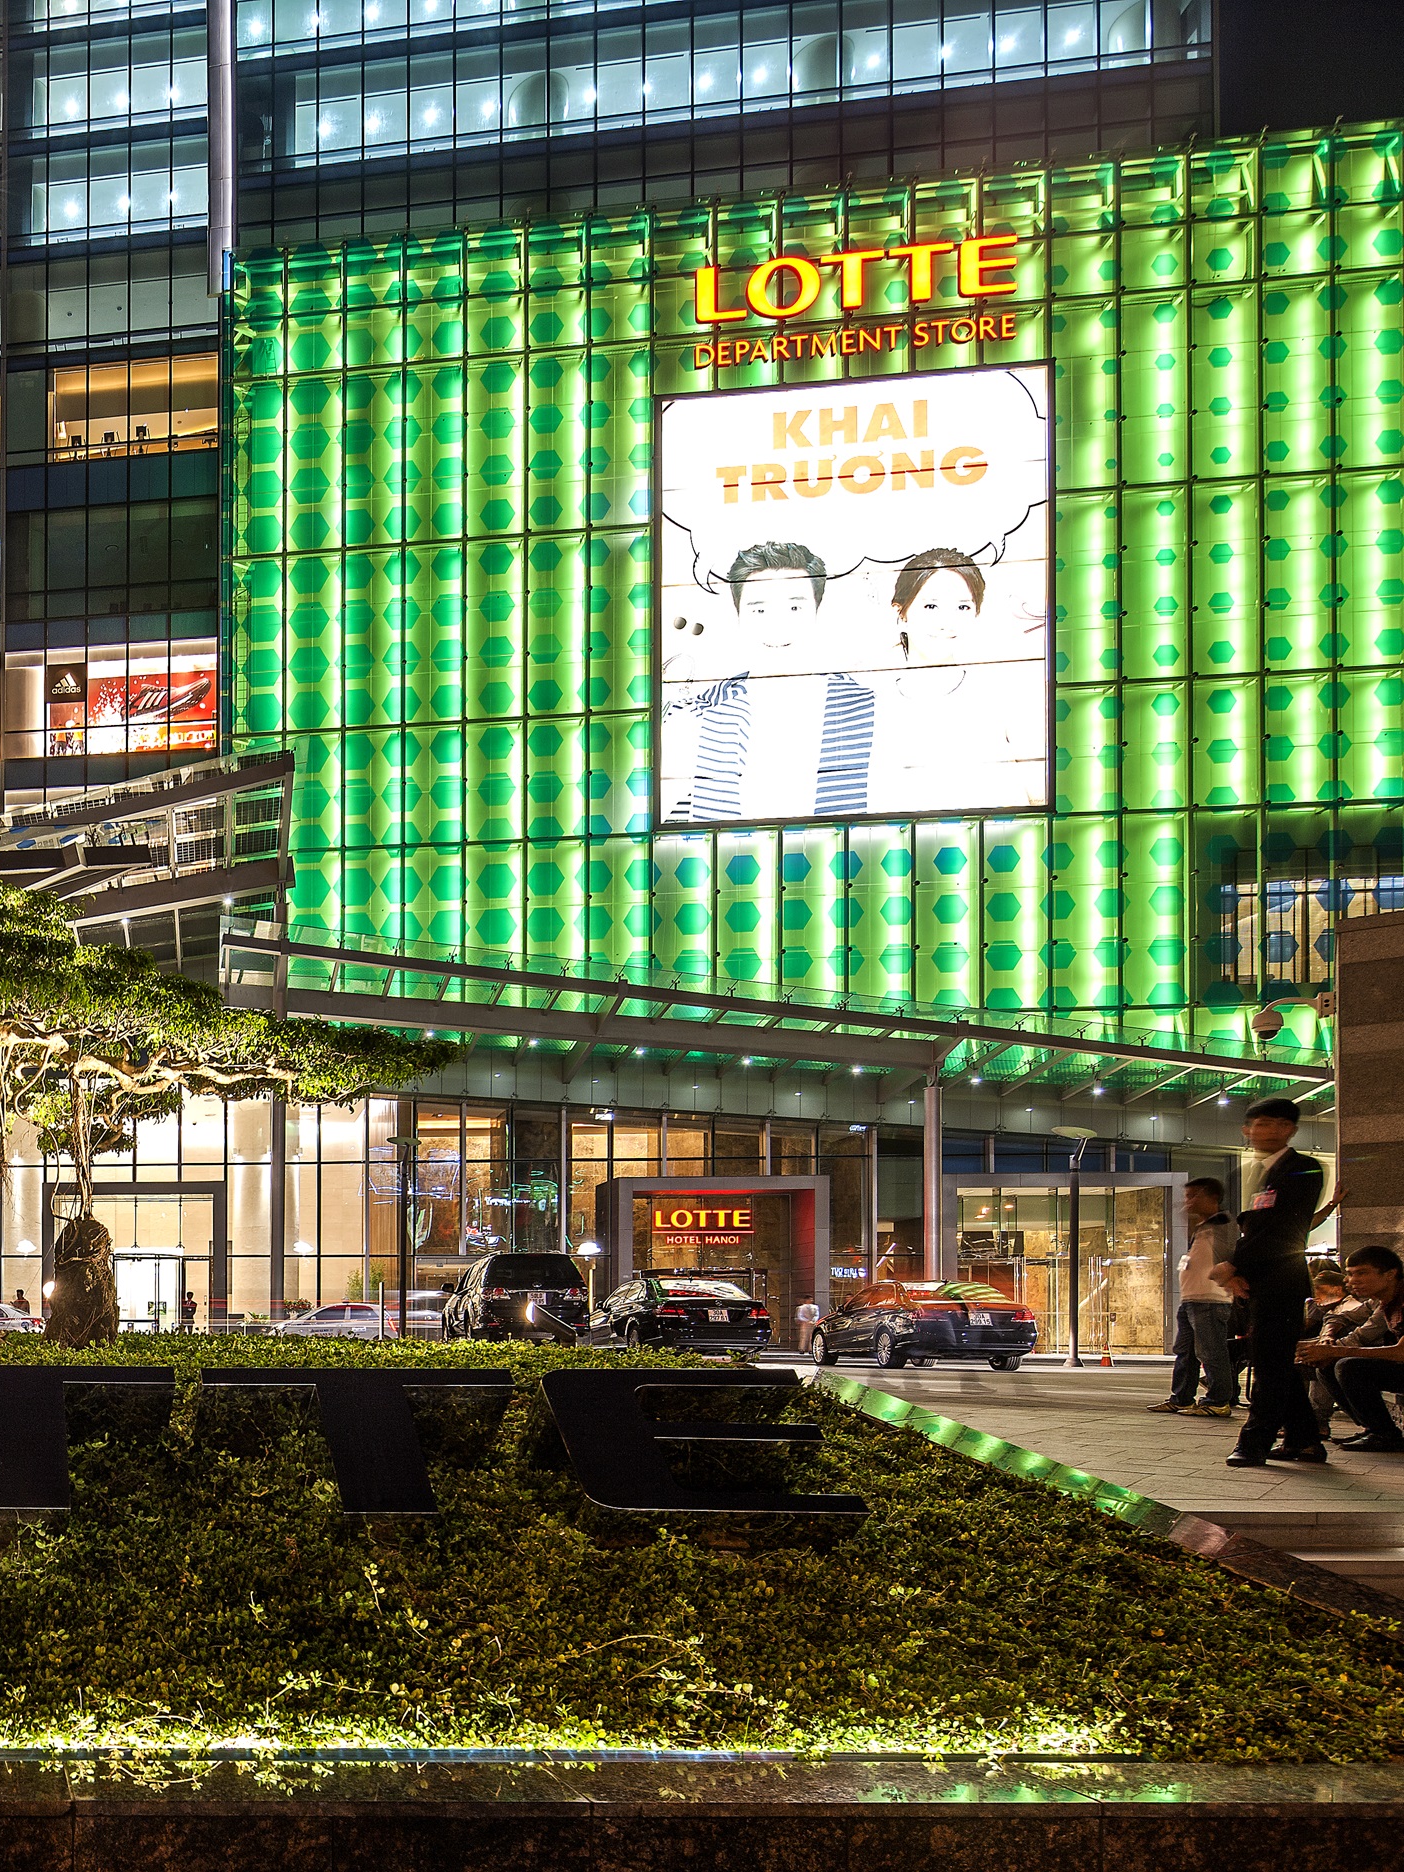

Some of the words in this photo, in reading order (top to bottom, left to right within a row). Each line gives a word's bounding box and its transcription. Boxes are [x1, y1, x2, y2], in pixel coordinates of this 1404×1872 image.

[695, 234, 1019, 324] LOTTE
[694, 324, 903, 368] DEPARTMENT
[912, 314, 1018, 349] STORE
[772, 399, 929, 450] KHAI
[715, 446, 988, 504] TRƯƠNG
[51, 684, 82, 695] adidas
[653, 1209, 752, 1228] LOTTE
[666, 1236, 702, 1244] HOTEL
[705, 1236, 740, 1244] HANOI
